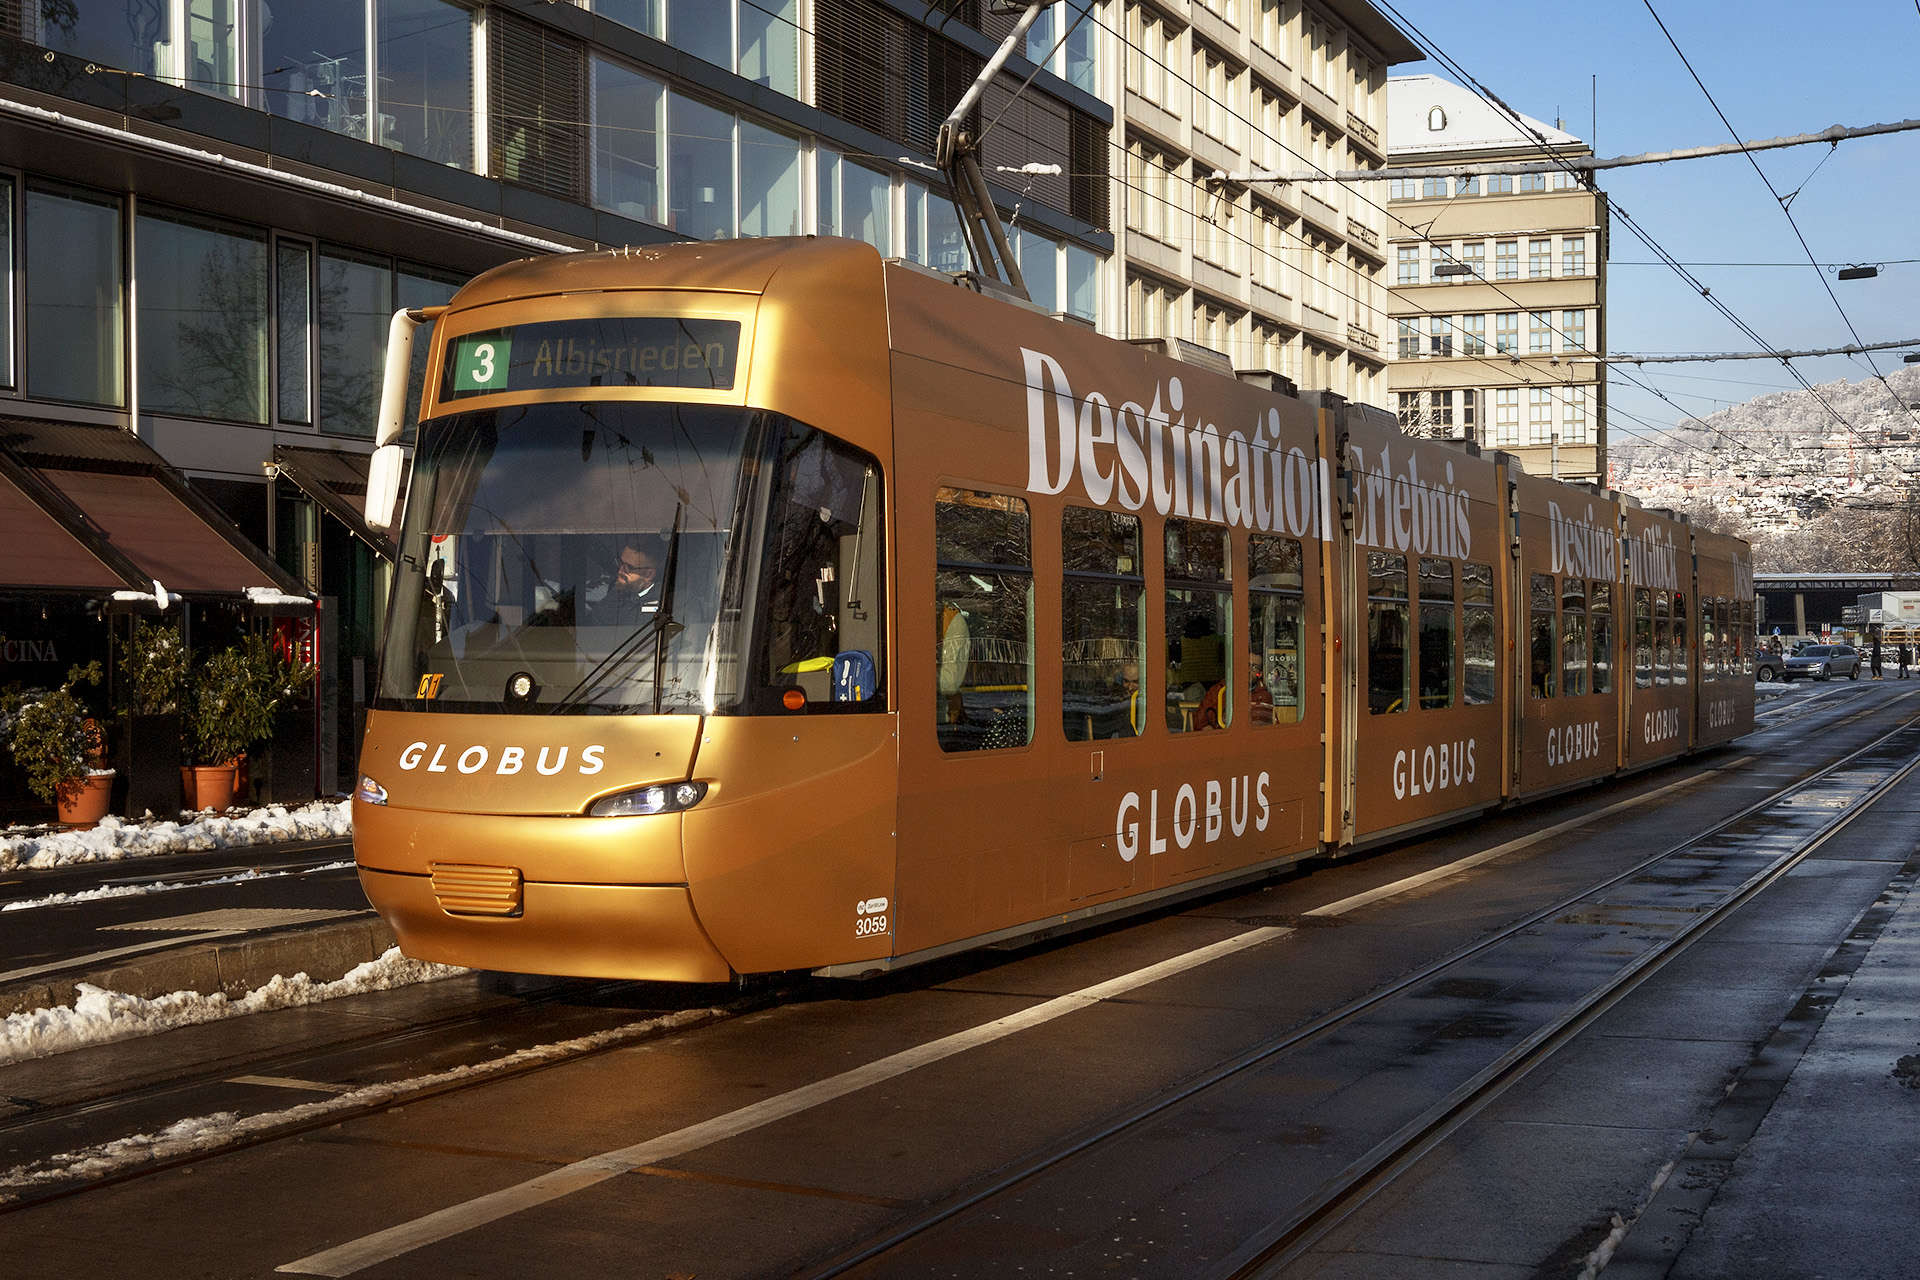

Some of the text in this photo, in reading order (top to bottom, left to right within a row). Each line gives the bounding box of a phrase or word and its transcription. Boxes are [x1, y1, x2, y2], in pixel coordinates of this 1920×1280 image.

[472, 336, 726, 383] 3 Albisrieden
[1019, 347, 1471, 561] Destination Erlebnis
[1643, 522, 1679, 590] Glück
[0, 639, 59, 663] CINA
[1644, 707, 1679, 744] GLOBUS
[1709, 698, 1735, 729] GLOBUS
[399, 741, 605, 776] GLOBUS
[1547, 721, 1599, 767] GLOBUS
[1393, 738, 1476, 800] GLOBUS
[1116, 771, 1270, 862] GLOBUS
[856, 915, 887, 936] 3059
